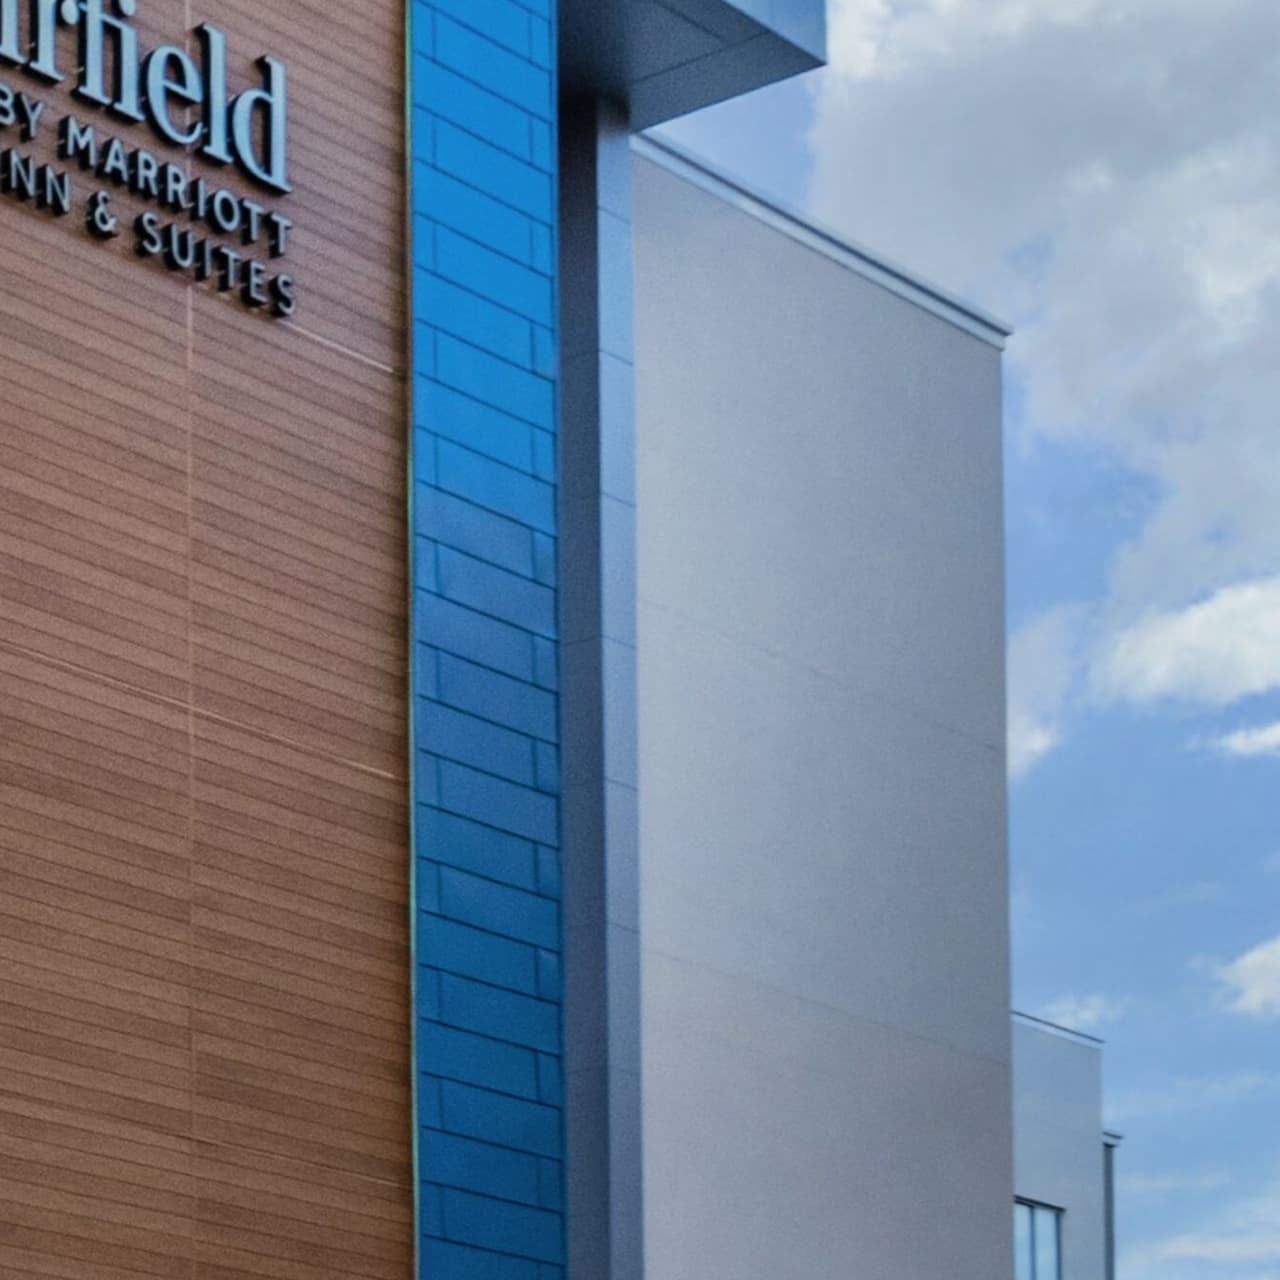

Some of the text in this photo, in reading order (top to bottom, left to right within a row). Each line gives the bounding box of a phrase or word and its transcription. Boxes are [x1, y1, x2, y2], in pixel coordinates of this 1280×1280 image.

[59, 114, 293, 257] MARRIOTT
[89, 189, 119, 238] &
[136, 211, 296, 317] SUITES
